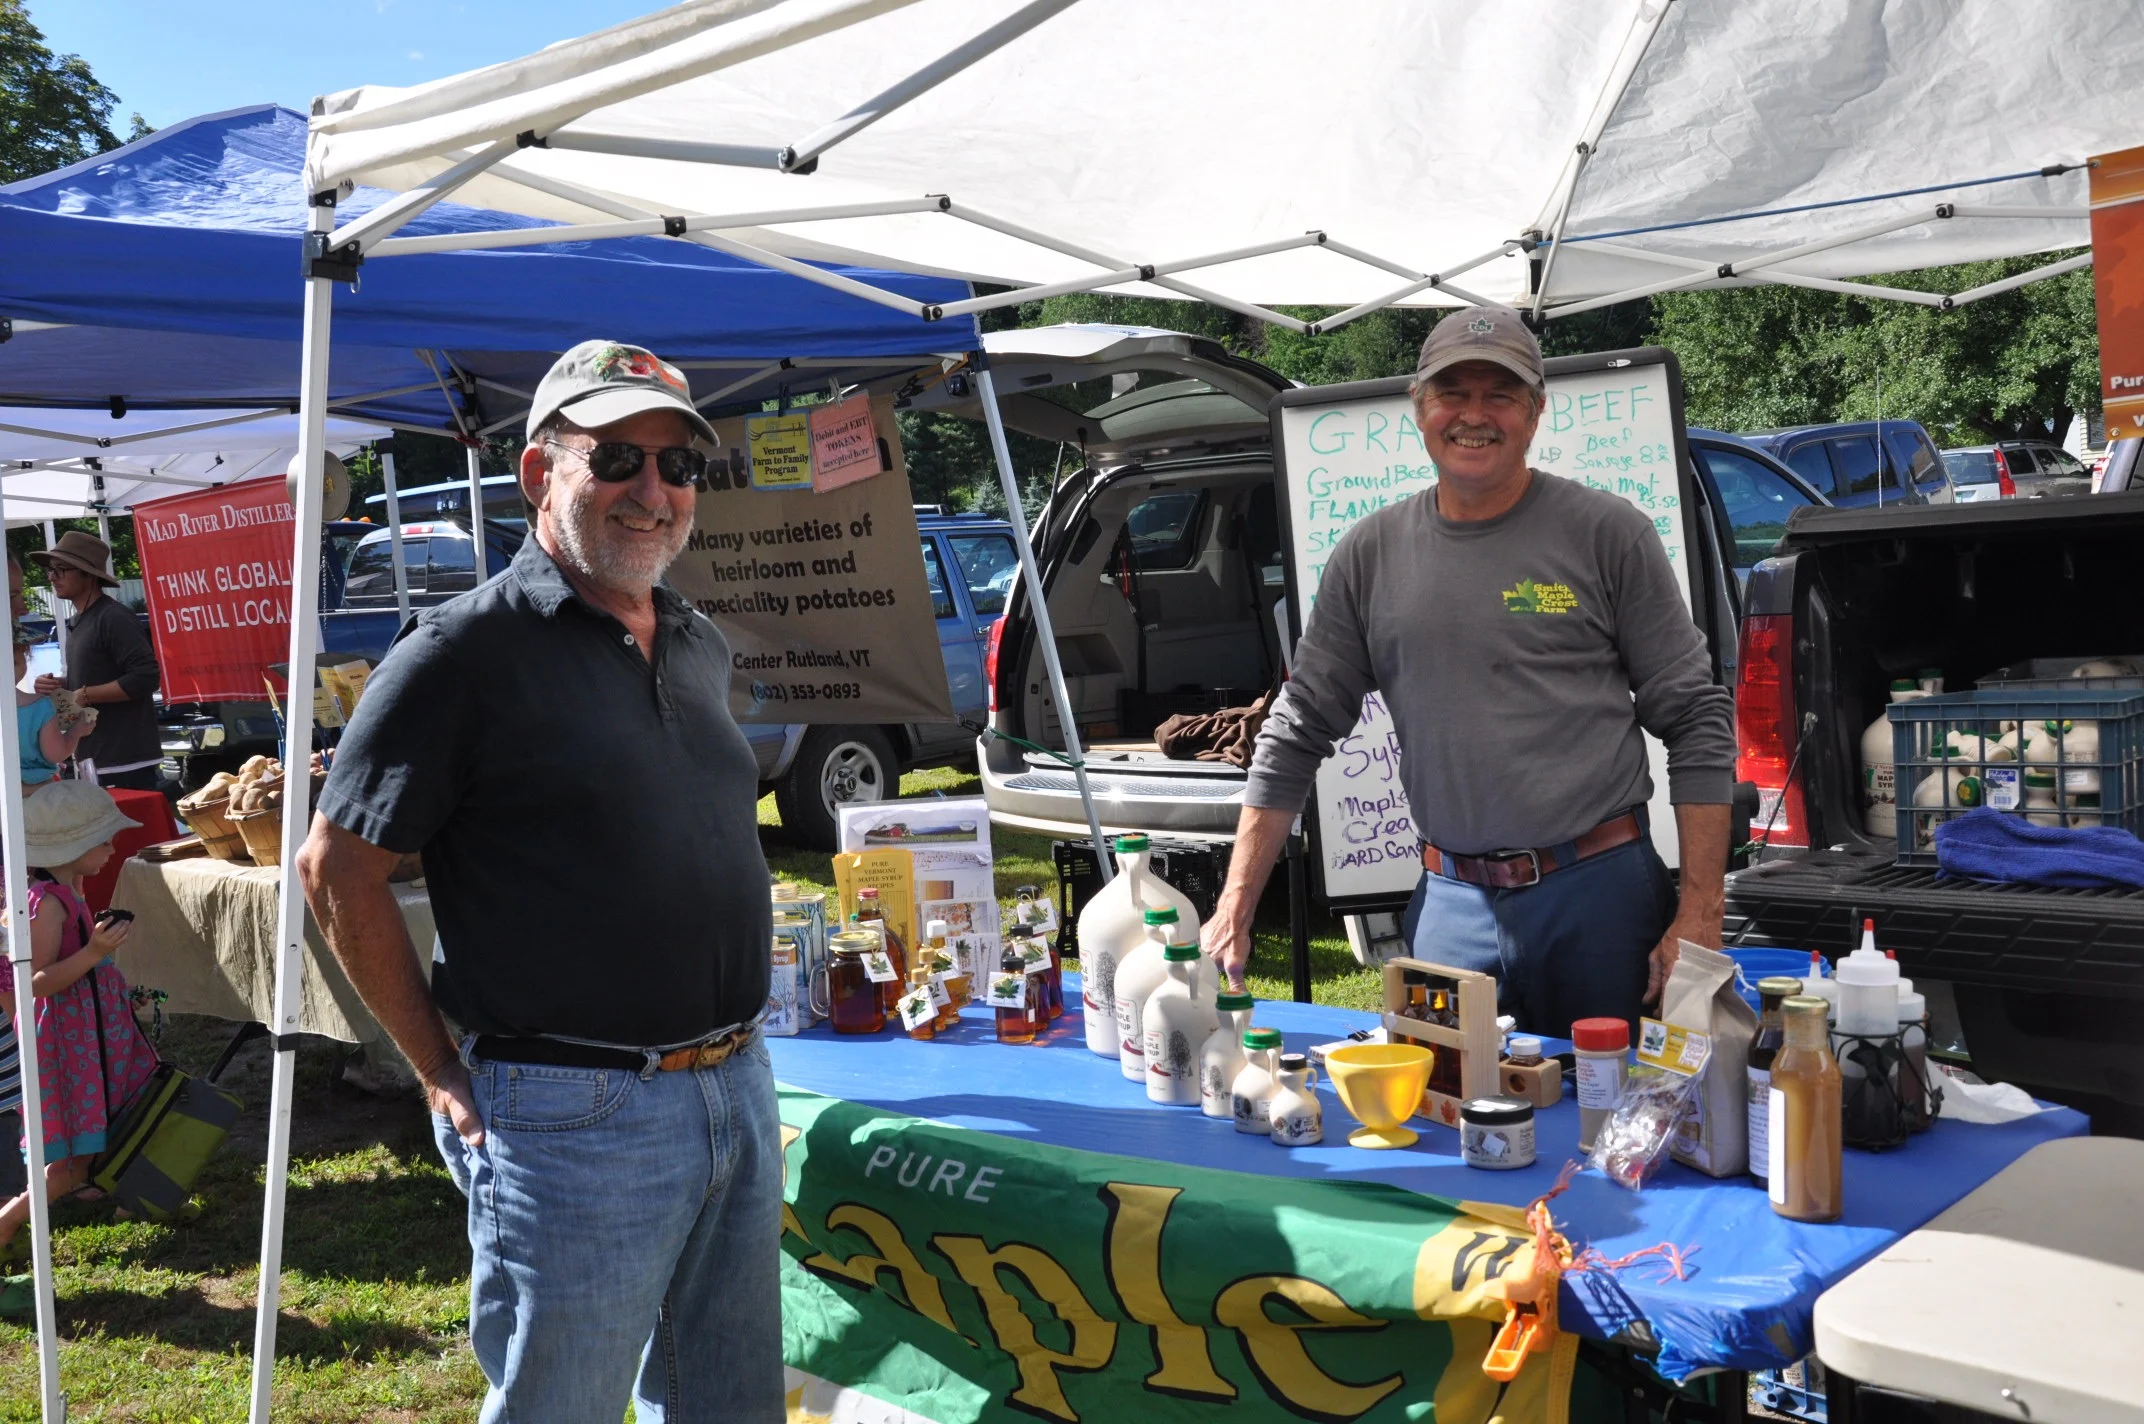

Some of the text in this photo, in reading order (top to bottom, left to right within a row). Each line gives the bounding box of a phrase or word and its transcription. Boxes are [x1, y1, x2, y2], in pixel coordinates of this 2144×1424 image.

[2110, 375, 2144, 390] Pur
[815, 415, 868, 442] Debit and EBT
[1309, 384, 1654, 455] GRA BEEF
[763, 445, 796, 455] Vermont
[825, 434, 862, 452] TOKENS
[752, 454, 809, 466] Farm to Family
[764, 466, 799, 477] Program
[1307, 466, 1391, 498] Ground
[144, 518, 178, 544] MAD
[178, 513, 221, 537] RIVER
[688, 512, 873, 553] Many varieties of
[711, 550, 858, 583] heirloom and
[157, 559, 293, 599] THINK GLOBAL
[696, 587, 897, 617] speciality potatoes
[1537, 590, 1575, 601] Maple
[1541, 598, 1579, 608] Crest
[164, 598, 292, 634] DISTILL LOCAL
[1535, 605, 1568, 613] Farm
[732, 649, 871, 669] Center Rutland, VT
[750, 682, 861, 703] (802) 353-0893
[1343, 817, 1412, 845] Crea
[1385, 840, 1422, 860] Can
[864, 868, 896, 876] VERMONT
[871, 860, 888, 868] PURE
[773, 953, 789, 964] Syrup
[864, 1145, 1005, 1204] PURE
[783, 1180, 1405, 1424] aple
